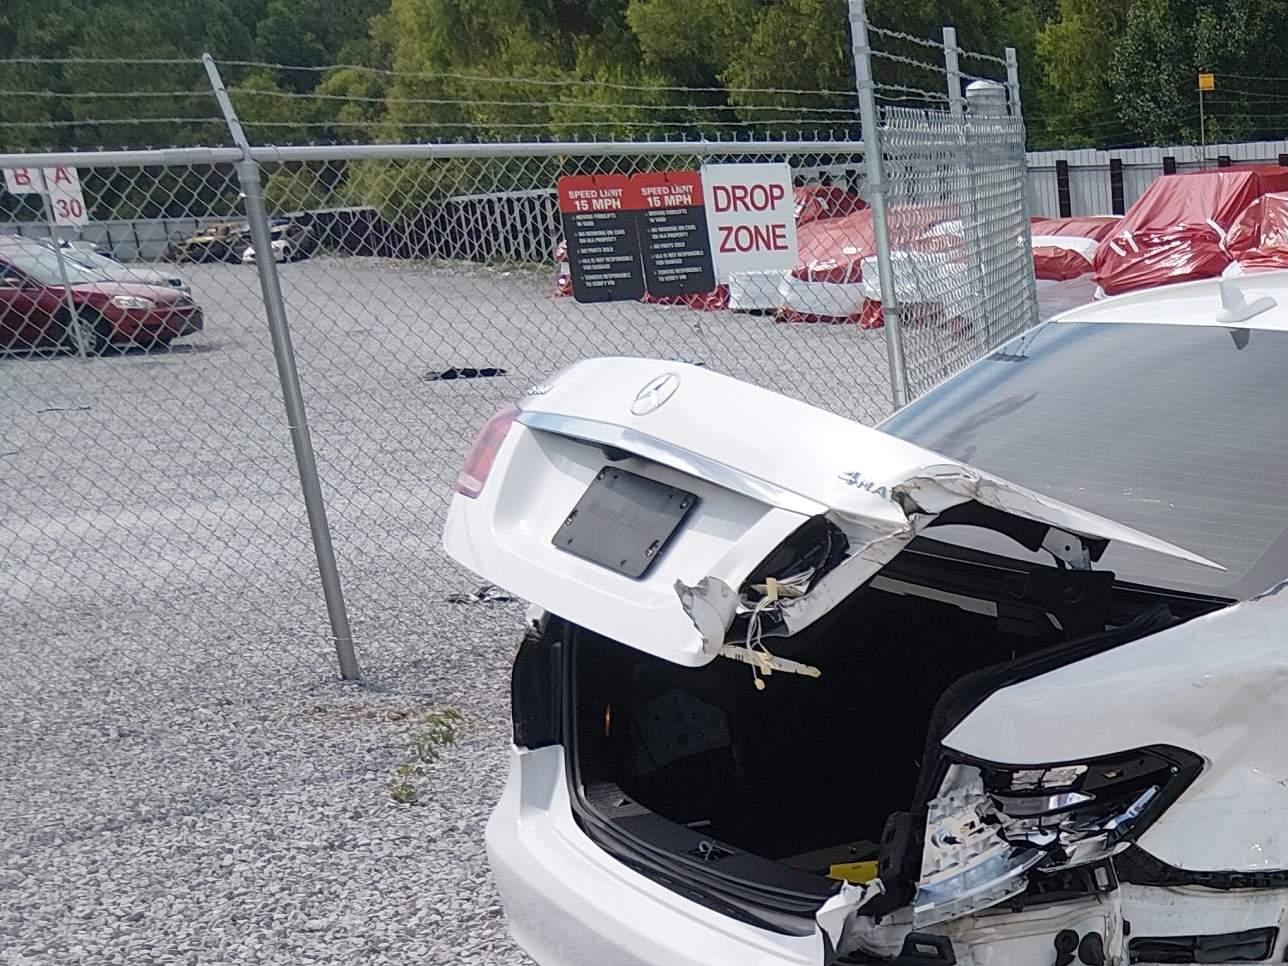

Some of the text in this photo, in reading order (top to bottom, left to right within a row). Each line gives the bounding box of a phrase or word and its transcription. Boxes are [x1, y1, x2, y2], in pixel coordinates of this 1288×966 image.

[568, 189, 623, 199] SPEED LIMIT
[641, 184, 694, 196] SPEED LIMIT
[574, 198, 622, 211] 15 MPH
[647, 194, 692, 208] 15 MPH
[712, 184, 785, 213] DROP
[56, 199, 82, 218] 30
[718, 224, 789, 253] ZONE
[838, 472, 892, 498] 4MA
